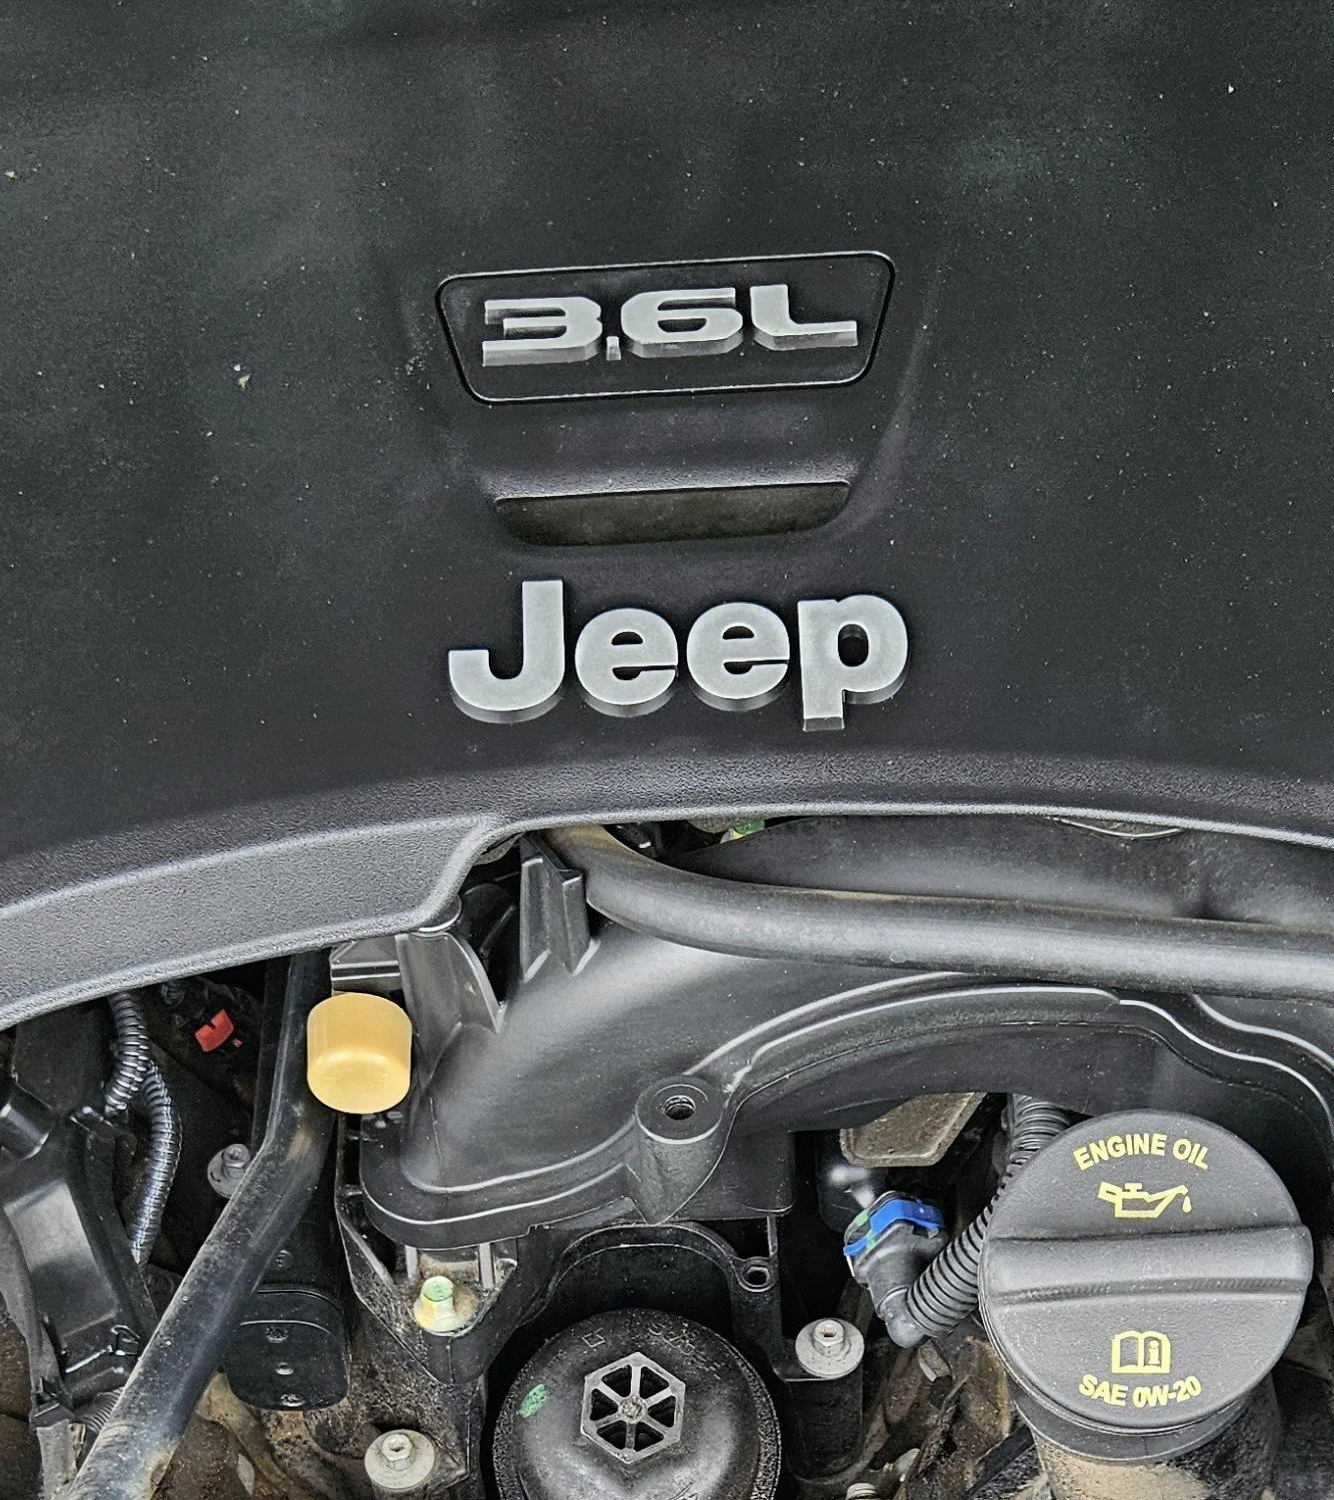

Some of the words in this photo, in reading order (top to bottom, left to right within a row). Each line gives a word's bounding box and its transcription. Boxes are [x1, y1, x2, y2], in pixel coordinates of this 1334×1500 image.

[482, 283, 858, 366] 3.6L
[447, 579, 909, 732] Jeep
[1073, 1132, 1167, 1171] ENGINE
[1172, 1137, 1211, 1170] OIL
[1078, 1372, 1127, 1407] SAE
[1132, 1374, 1202, 1409] 0W-20
